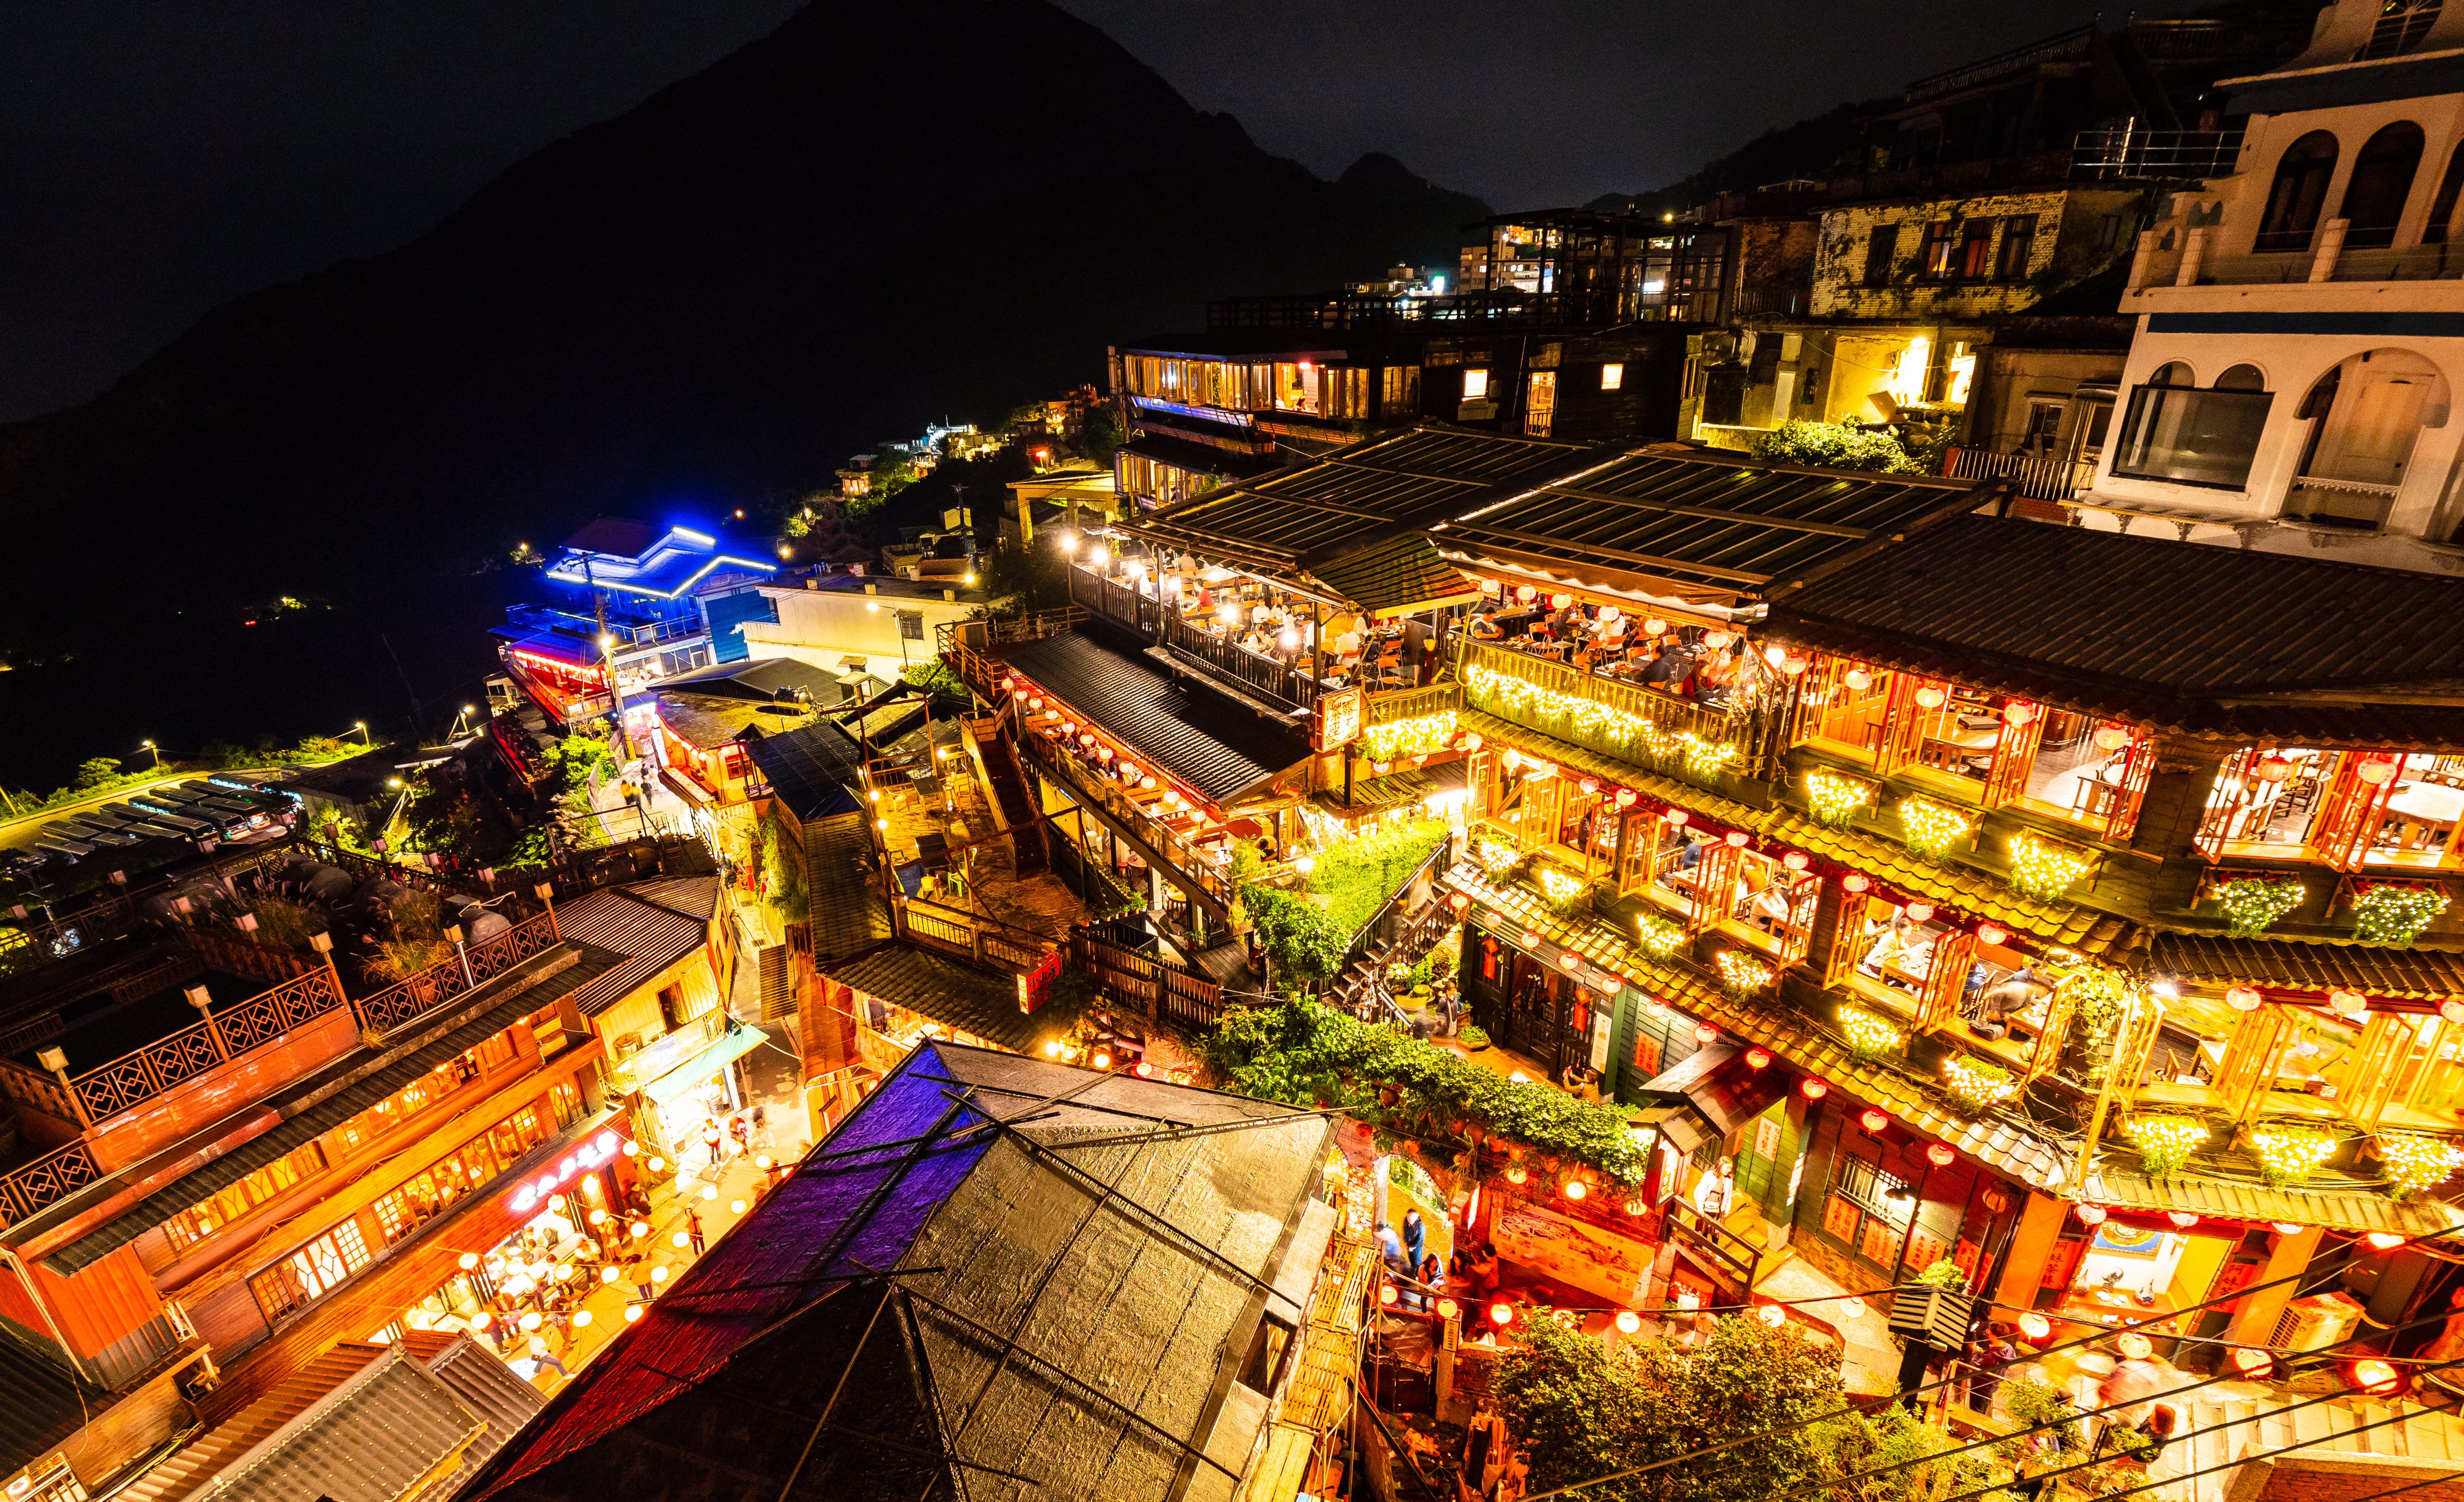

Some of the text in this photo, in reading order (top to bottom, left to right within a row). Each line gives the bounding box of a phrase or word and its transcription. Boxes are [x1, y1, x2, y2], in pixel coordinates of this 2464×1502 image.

[1029, 964, 1057, 988] 小上海
[2042, 1241, 2070, 1286] 阿妹茶樓
